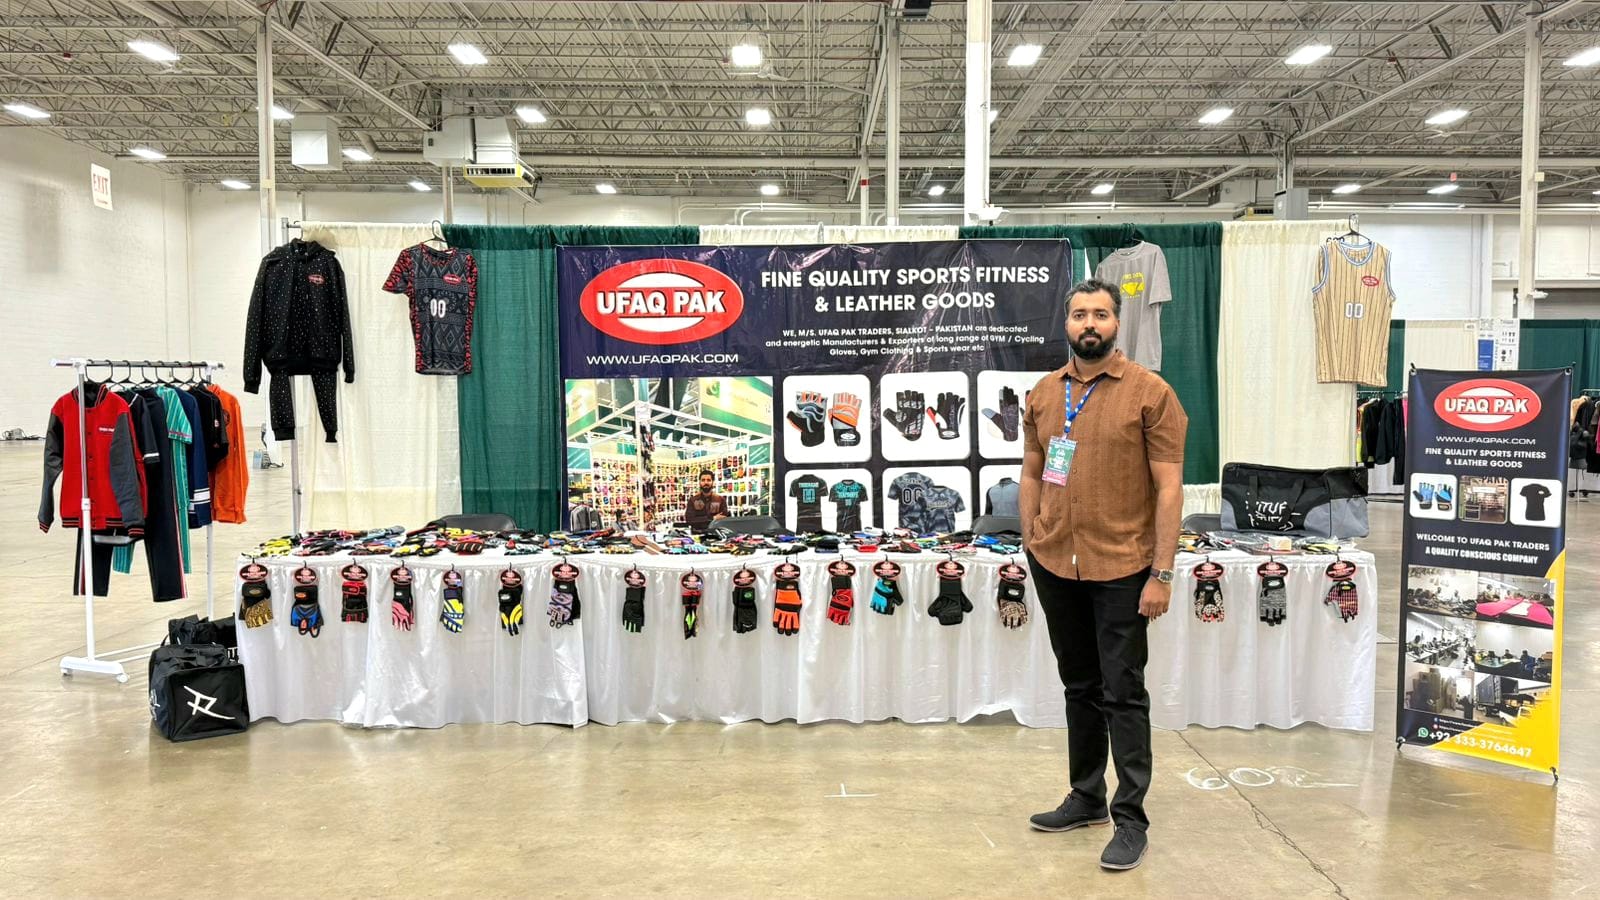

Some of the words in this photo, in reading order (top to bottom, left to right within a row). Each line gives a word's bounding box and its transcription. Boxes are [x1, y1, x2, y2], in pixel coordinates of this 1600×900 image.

[761, 271, 803, 288] FINE
[808, 269, 891, 288] QUALITY
[896, 266, 971, 285] SPORTS
[976, 266, 1050, 283] FITNESS
[430, 298, 447, 319] 00
[596, 291, 667, 316] UFAQ
[673, 290, 727, 314] PAK
[814, 296, 829, 312] &
[836, 294, 917, 312] LEATHER
[922, 291, 996, 310] GOODS
[1345, 302, 1364, 319] 00
[783, 329, 797, 338] WE,
[818, 328, 839, 337] UFAQ
[841, 328, 857, 336] PAK
[858, 326, 894, 336] TRADERS,
[896, 326, 927, 335] SIALKOT
[935, 325, 973, 334] PAKISTAN
[988, 325, 1028, 333] dedicated
[766, 339, 781, 347] and
[783, 338, 820, 348] energetic
[822, 338, 879, 346] Manufacturers
[888, 336, 924, 346] Exporters
[926, 335, 935, 343] of
[936, 335, 954, 344] long
[955, 336, 980, 344] range
[981, 334, 989, 342] of
[990, 335, 1006, 343] GYM
[1014, 335, 1045, 344] Cycling
[829, 348, 858, 356] Gloves,
[860, 347, 879, 356] Gym
[880, 346, 914, 356] Clothing
[923, 345, 949, 354] Sports
[586, 353, 739, 365] WWW.UFAQPAK.COM
[1444, 398, 1491, 414] UFAQ
[1493, 398, 1529, 414] PAK
[1436, 436, 1536, 445] WWW.UFAQPAK.COM
[1443, 448, 1478, 457] QUALITY
[1479, 449, 1512, 458] SPORTS
[1513, 450, 1547, 459] FITNESS
[1454, 458, 1488, 467] LEATHER
[1490, 459, 1523, 468] GOODS
[1416, 533, 1455, 544] WELCOME
[1457, 536, 1468, 544] TO
[1470, 537, 1492, 546] UFAQ
[1494, 539, 1511, 548] PAK
[1512, 540, 1551, 552] TRADERS
[1425, 546, 1431, 554] A
[1431, 547, 1459, 557] QUALITY
[1460, 549, 1501, 561] CONSCIOUS
[1502, 553, 1538, 565] COMPANY
[1429, 731, 1450, 742] +92
